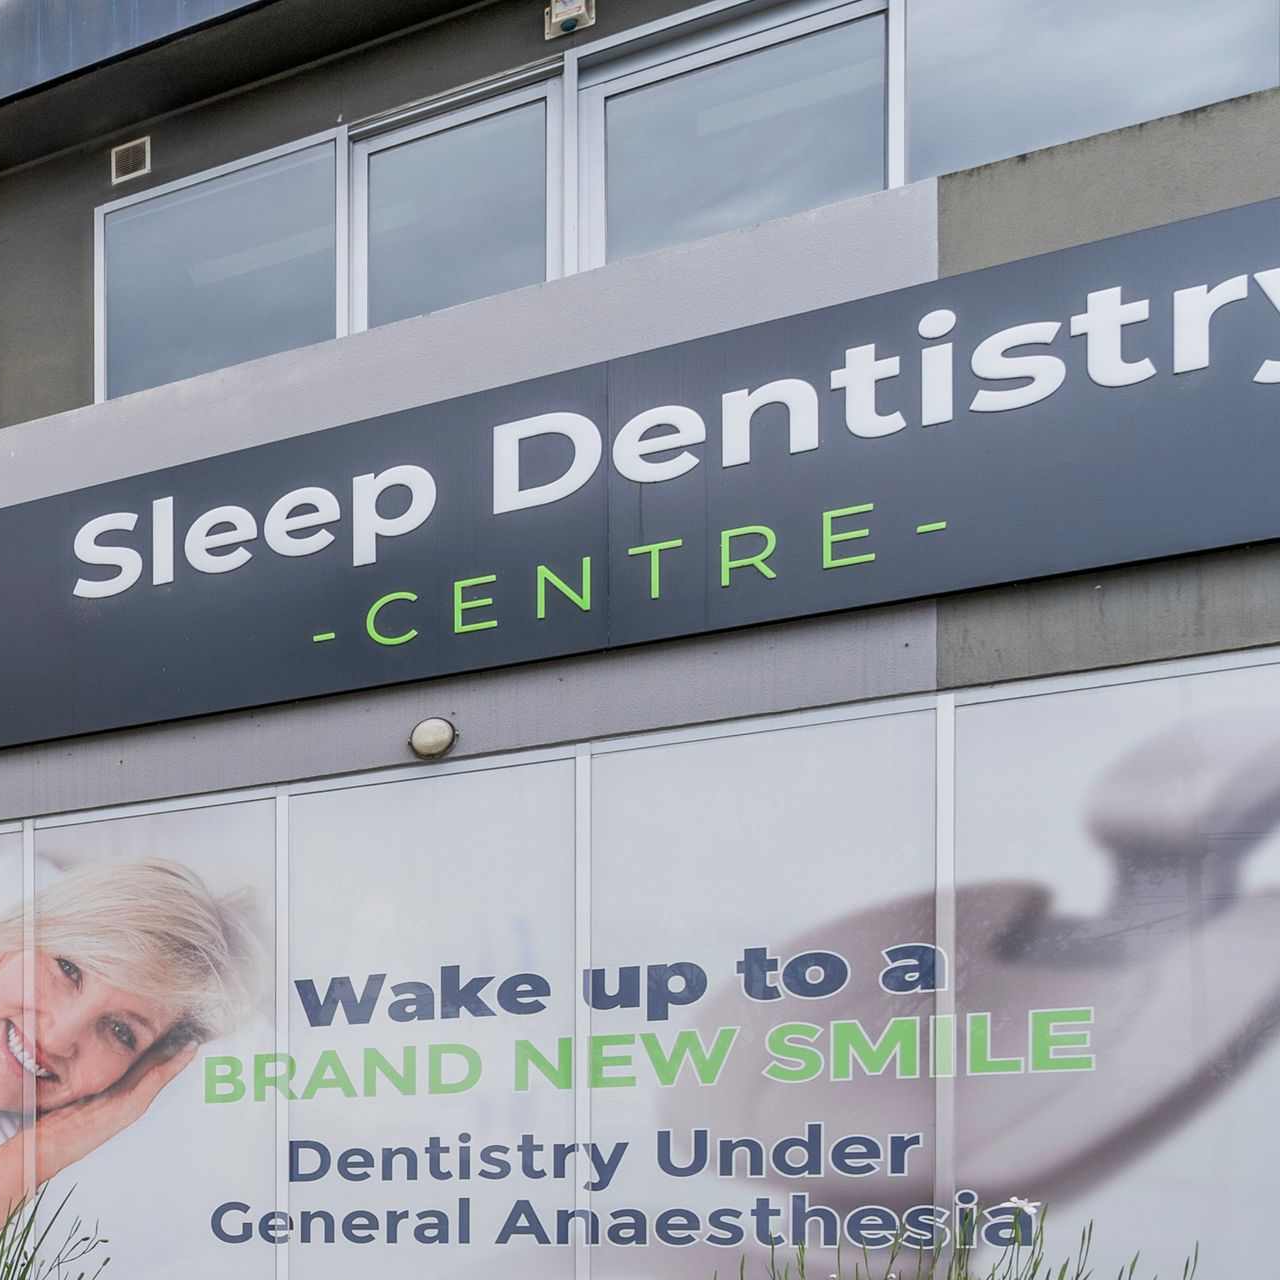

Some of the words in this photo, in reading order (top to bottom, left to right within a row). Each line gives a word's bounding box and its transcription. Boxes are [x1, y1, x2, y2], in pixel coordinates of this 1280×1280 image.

[72, 463, 438, 599] Sleep
[294, 964, 552, 1027] Wake
[582, 961, 709, 1023] up
[735, 945, 849, 1002] to
[882, 945, 949, 993] a
[202, 1041, 484, 1105] BRAND
[513, 1027, 738, 1090] NEW
[764, 1005, 1097, 1083] SMILE
[287, 1132, 630, 1192] Dentistry
[657, 1122, 922, 1178] Under
[209, 1197, 472, 1246] General
[494, 1191, 1035, 1250] Anaesthesia
